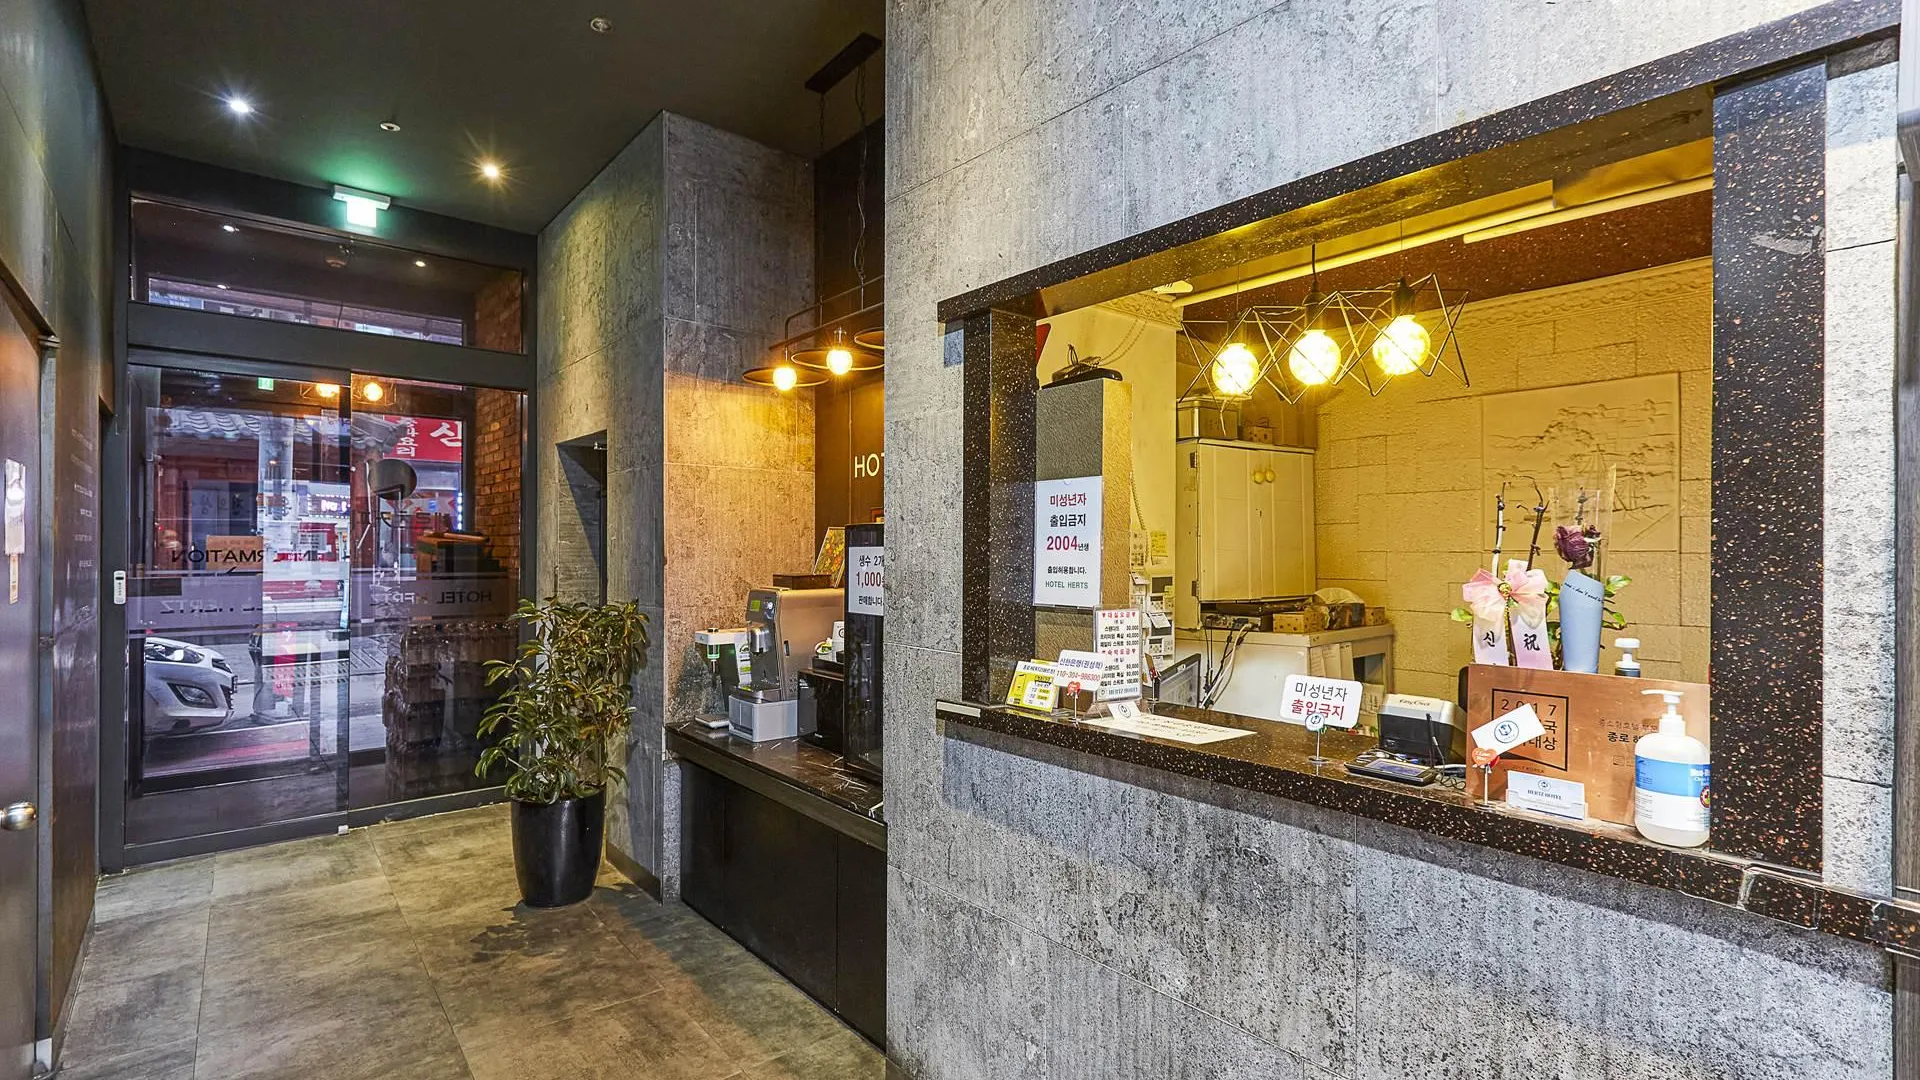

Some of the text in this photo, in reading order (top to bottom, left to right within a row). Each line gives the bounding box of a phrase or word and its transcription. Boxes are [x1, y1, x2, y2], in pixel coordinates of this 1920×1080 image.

[854, 453, 885, 478] HO
[1050, 492, 1088, 508] 미성년자
[1050, 514, 1087, 528] 출입금지
[1046, 535, 1090, 552] 2004년생
[1047, 565, 1088, 575] 출입허용합니다.
[1045, 580, 1089, 590] HOTEL HERTS
[1483, 630, 1496, 648] 신
[1523, 633, 1541, 652] 祝
[1295, 682, 1348, 702] 미성년자
[1291, 699, 1345, 721] 출입금지
[1607, 731, 1630, 743] 종로
